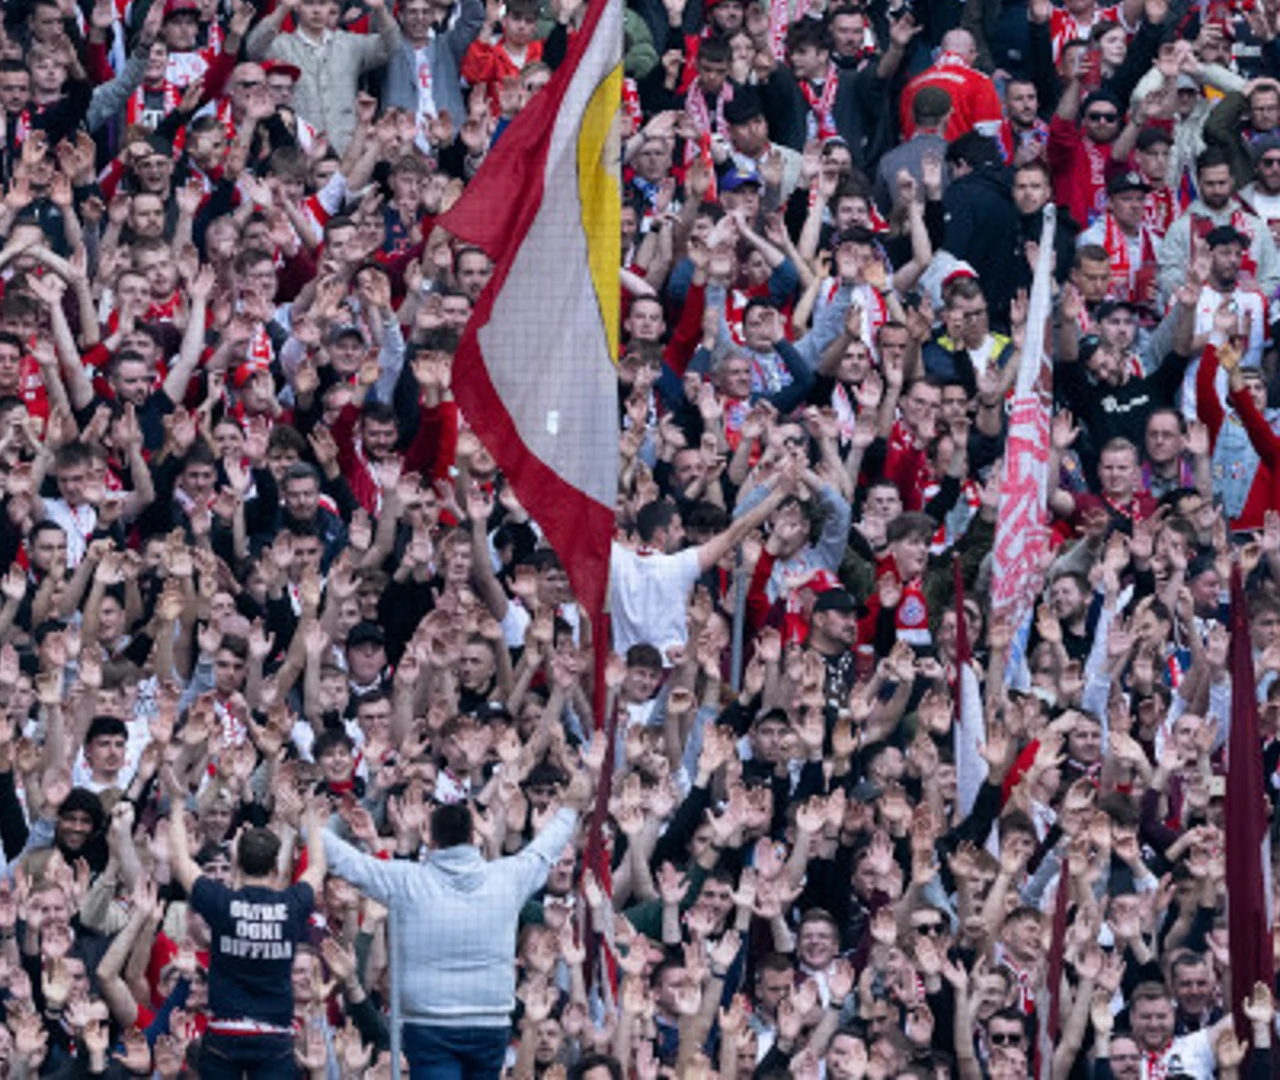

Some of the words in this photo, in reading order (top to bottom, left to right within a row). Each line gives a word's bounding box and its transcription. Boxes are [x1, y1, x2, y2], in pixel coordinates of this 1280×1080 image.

[230, 901, 288, 921] OLTRE
[236, 920, 282, 940] OGNI
[220, 935, 292, 959] DIFFIDA
